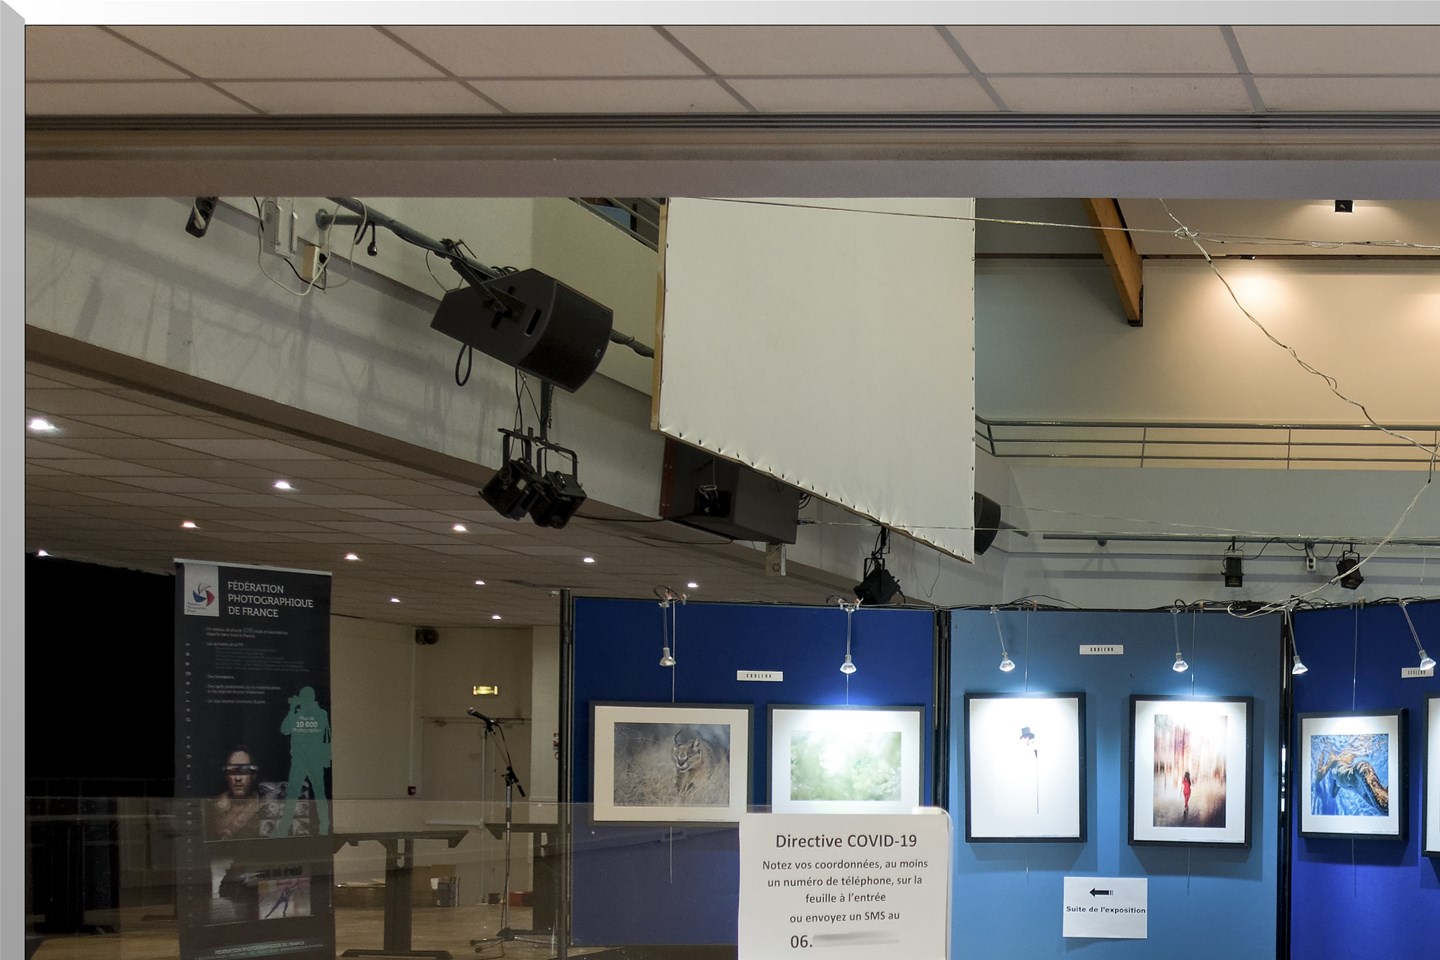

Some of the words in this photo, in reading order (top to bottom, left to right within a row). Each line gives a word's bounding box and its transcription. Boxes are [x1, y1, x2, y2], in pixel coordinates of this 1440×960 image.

[227, 580, 284, 594] FÉDÉRATION
[227, 593, 314, 609] PHOTOGRAPHIQUE
[228, 606, 241, 616] DE
[242, 606, 279, 618] FRANCE
[775, 834, 843, 848] Directive
[847, 834, 917, 848] COVID-19
[762, 860, 793, 870] Notez
[795, 862, 812, 870] vos
[814, 859, 883, 871] coordonnées,
[885, 861, 897, 869] au
[899, 858, 928, 869] moins
[767, 879, 781, 887] un
[783, 877, 824, 887] numéro
[826, 876, 839, 886] de
[841, 875, 895, 888] téléphone,
[896, 877, 912, 885] sur
[914, 875, 922, 885] la
[805, 893, 837, 904] feuille
[839, 893, 846, 903] à
[789, 915, 803, 924] ou
[805, 913, 847, 925] envoyez
[849, 913, 862, 921] un
[864, 911, 886, 921] SMS
[888, 912, 900, 920] au
